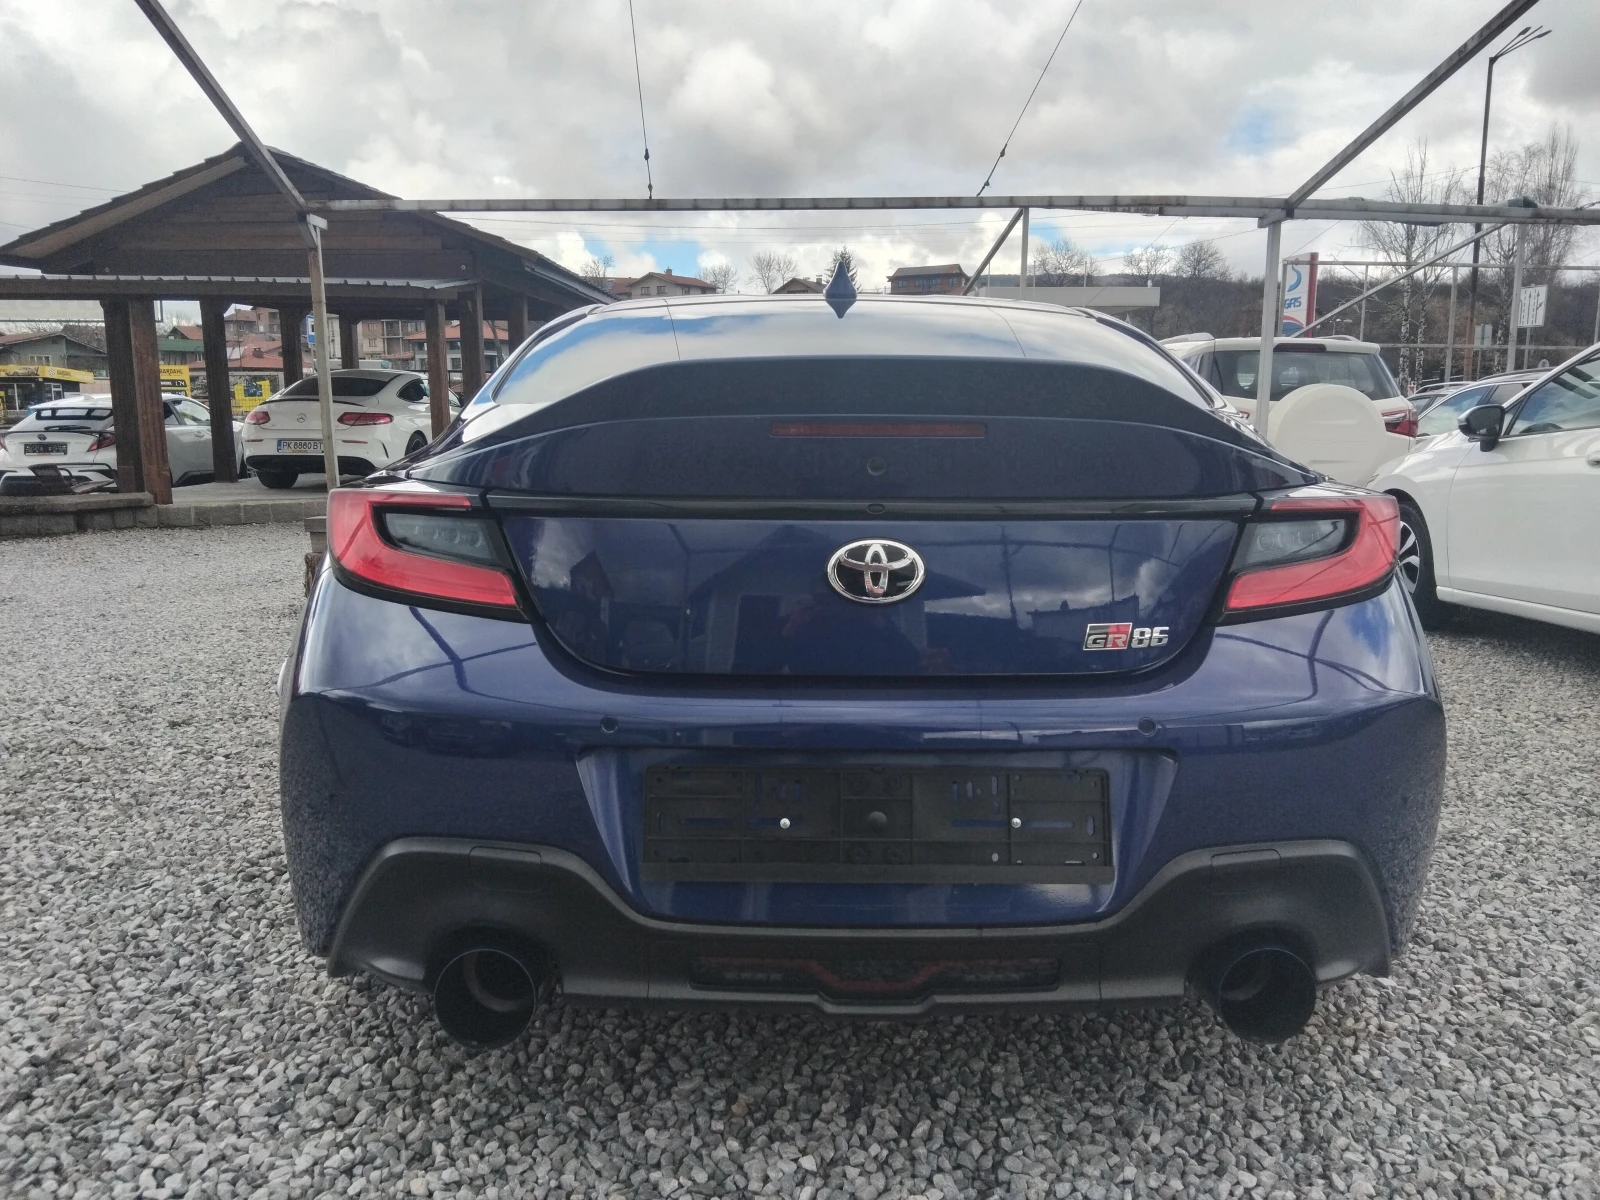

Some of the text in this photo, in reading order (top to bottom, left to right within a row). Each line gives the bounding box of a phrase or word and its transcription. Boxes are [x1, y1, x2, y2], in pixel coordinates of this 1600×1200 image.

[282, 441, 293, 450] PK
[313, 441, 323, 450] BT
[1086, 626, 1170, 648] GR 86
